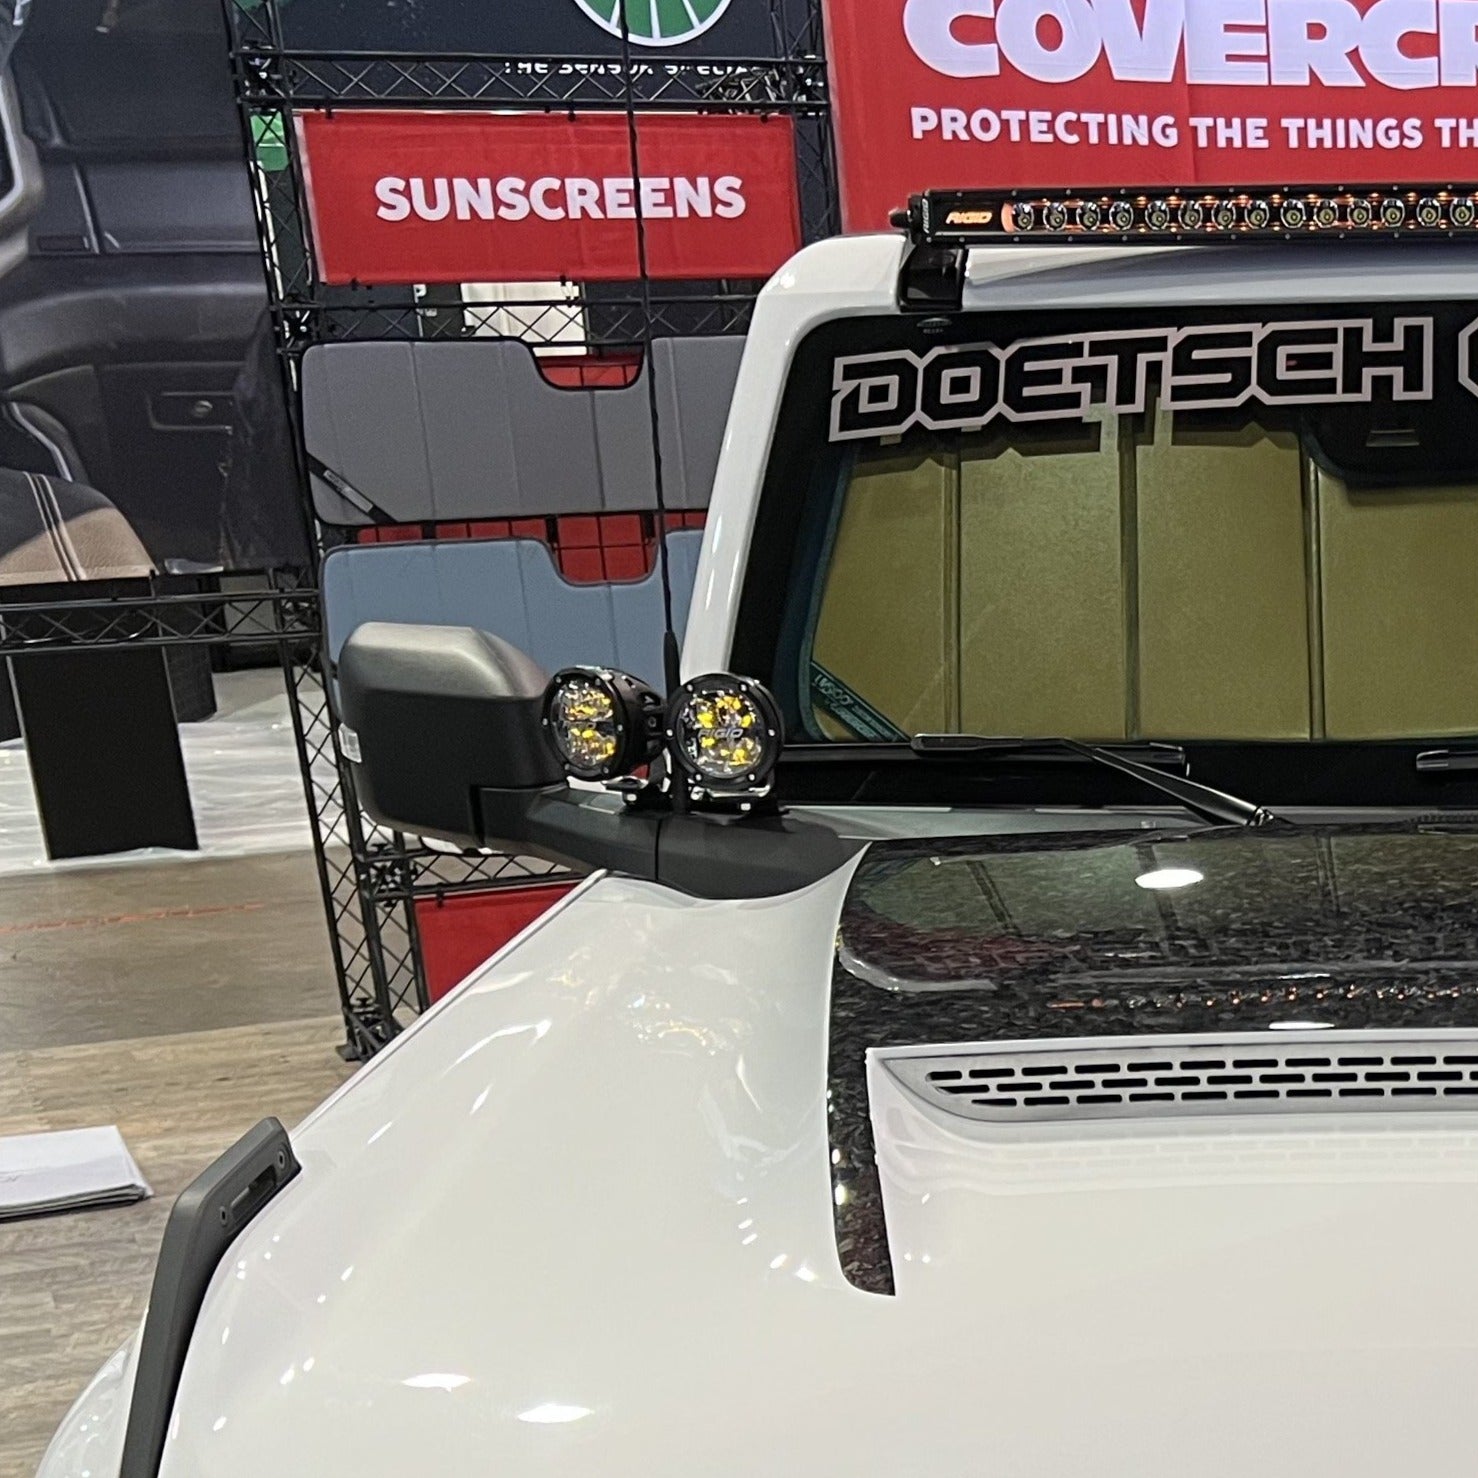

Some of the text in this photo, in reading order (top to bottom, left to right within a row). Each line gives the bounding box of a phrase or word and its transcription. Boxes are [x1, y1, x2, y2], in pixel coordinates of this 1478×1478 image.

[910, 106, 1179, 148] PROTECTING
[1188, 116, 1270, 149] THE
[1280, 116, 1424, 149] THINGS
[374, 175, 747, 222] SUNSCREENS
[828, 315, 1434, 443] DOETSCH
